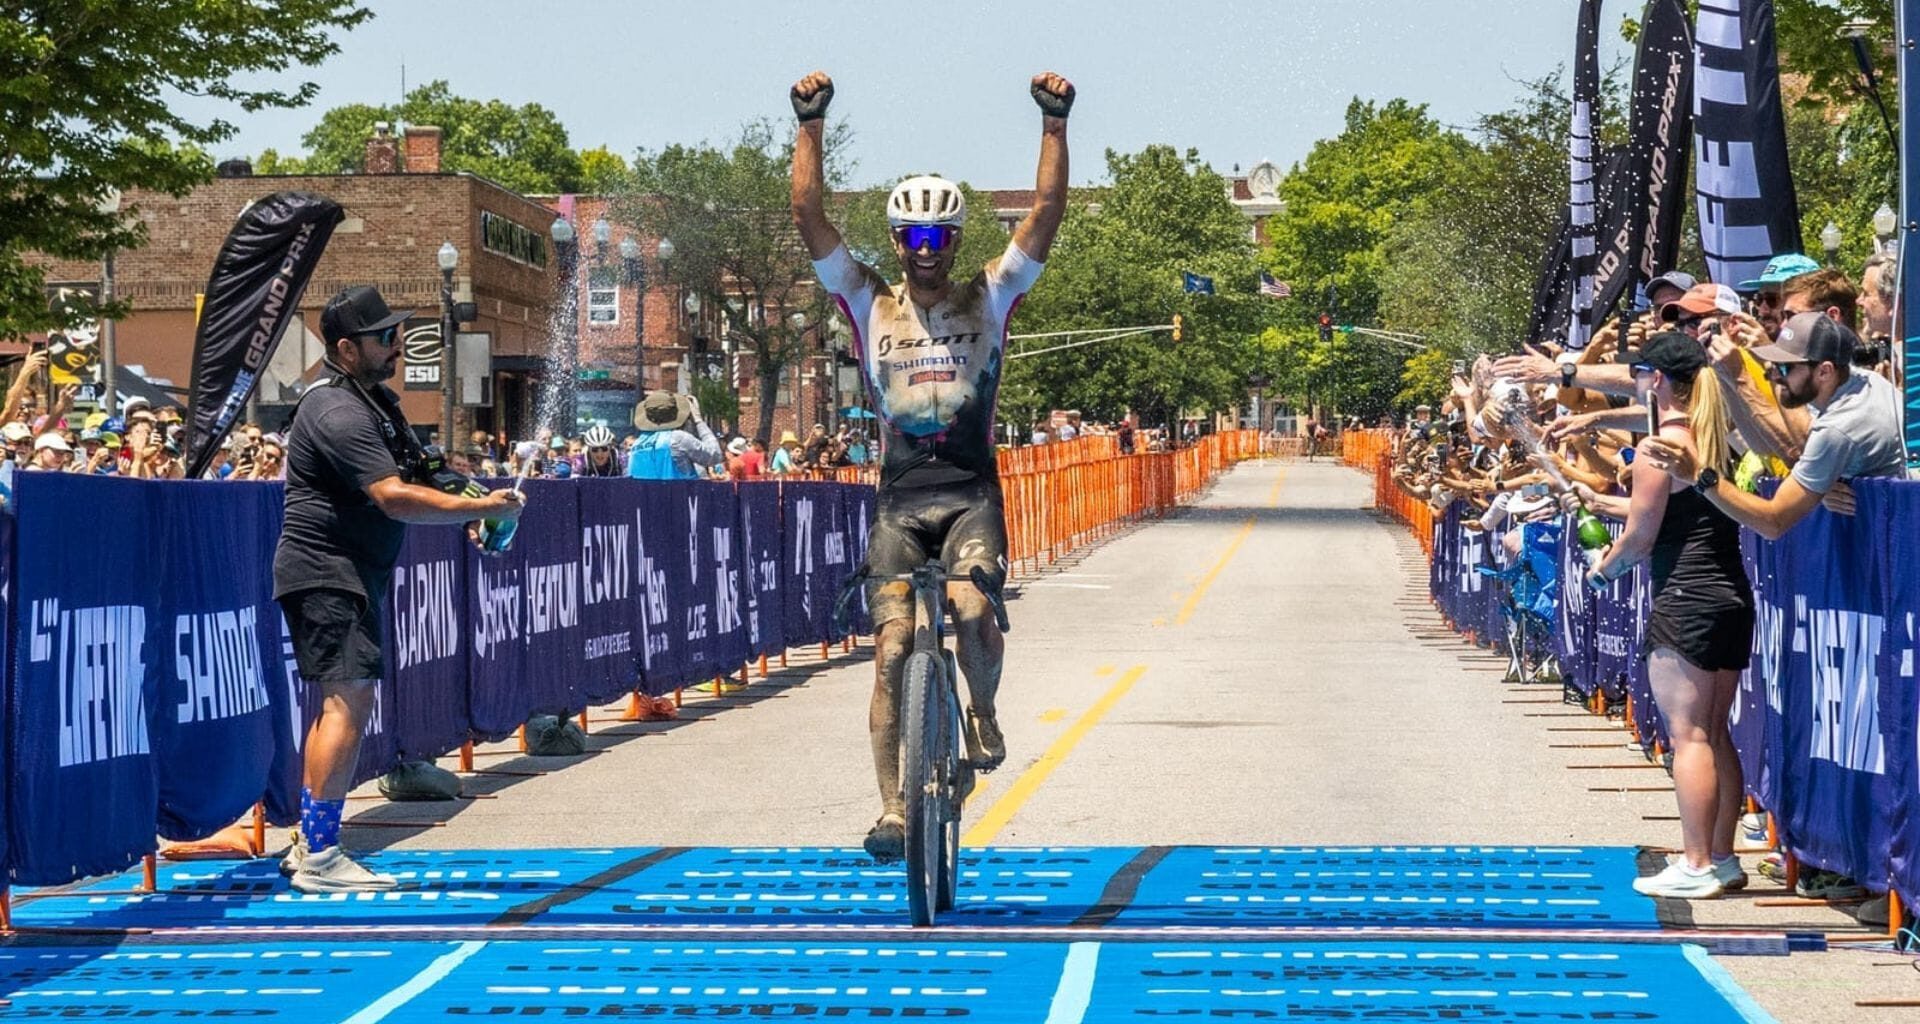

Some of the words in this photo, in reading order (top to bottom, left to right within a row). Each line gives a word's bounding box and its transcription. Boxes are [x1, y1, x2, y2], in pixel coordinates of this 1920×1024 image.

[245, 276, 288, 370] GRAND
[280, 223, 316, 279] PRIX
[894, 332, 983, 350] SCOTT
[893, 355, 968, 372] SHIMANO
[404, 365, 440, 383] ESU
[394, 559, 458, 670] GARMIN
